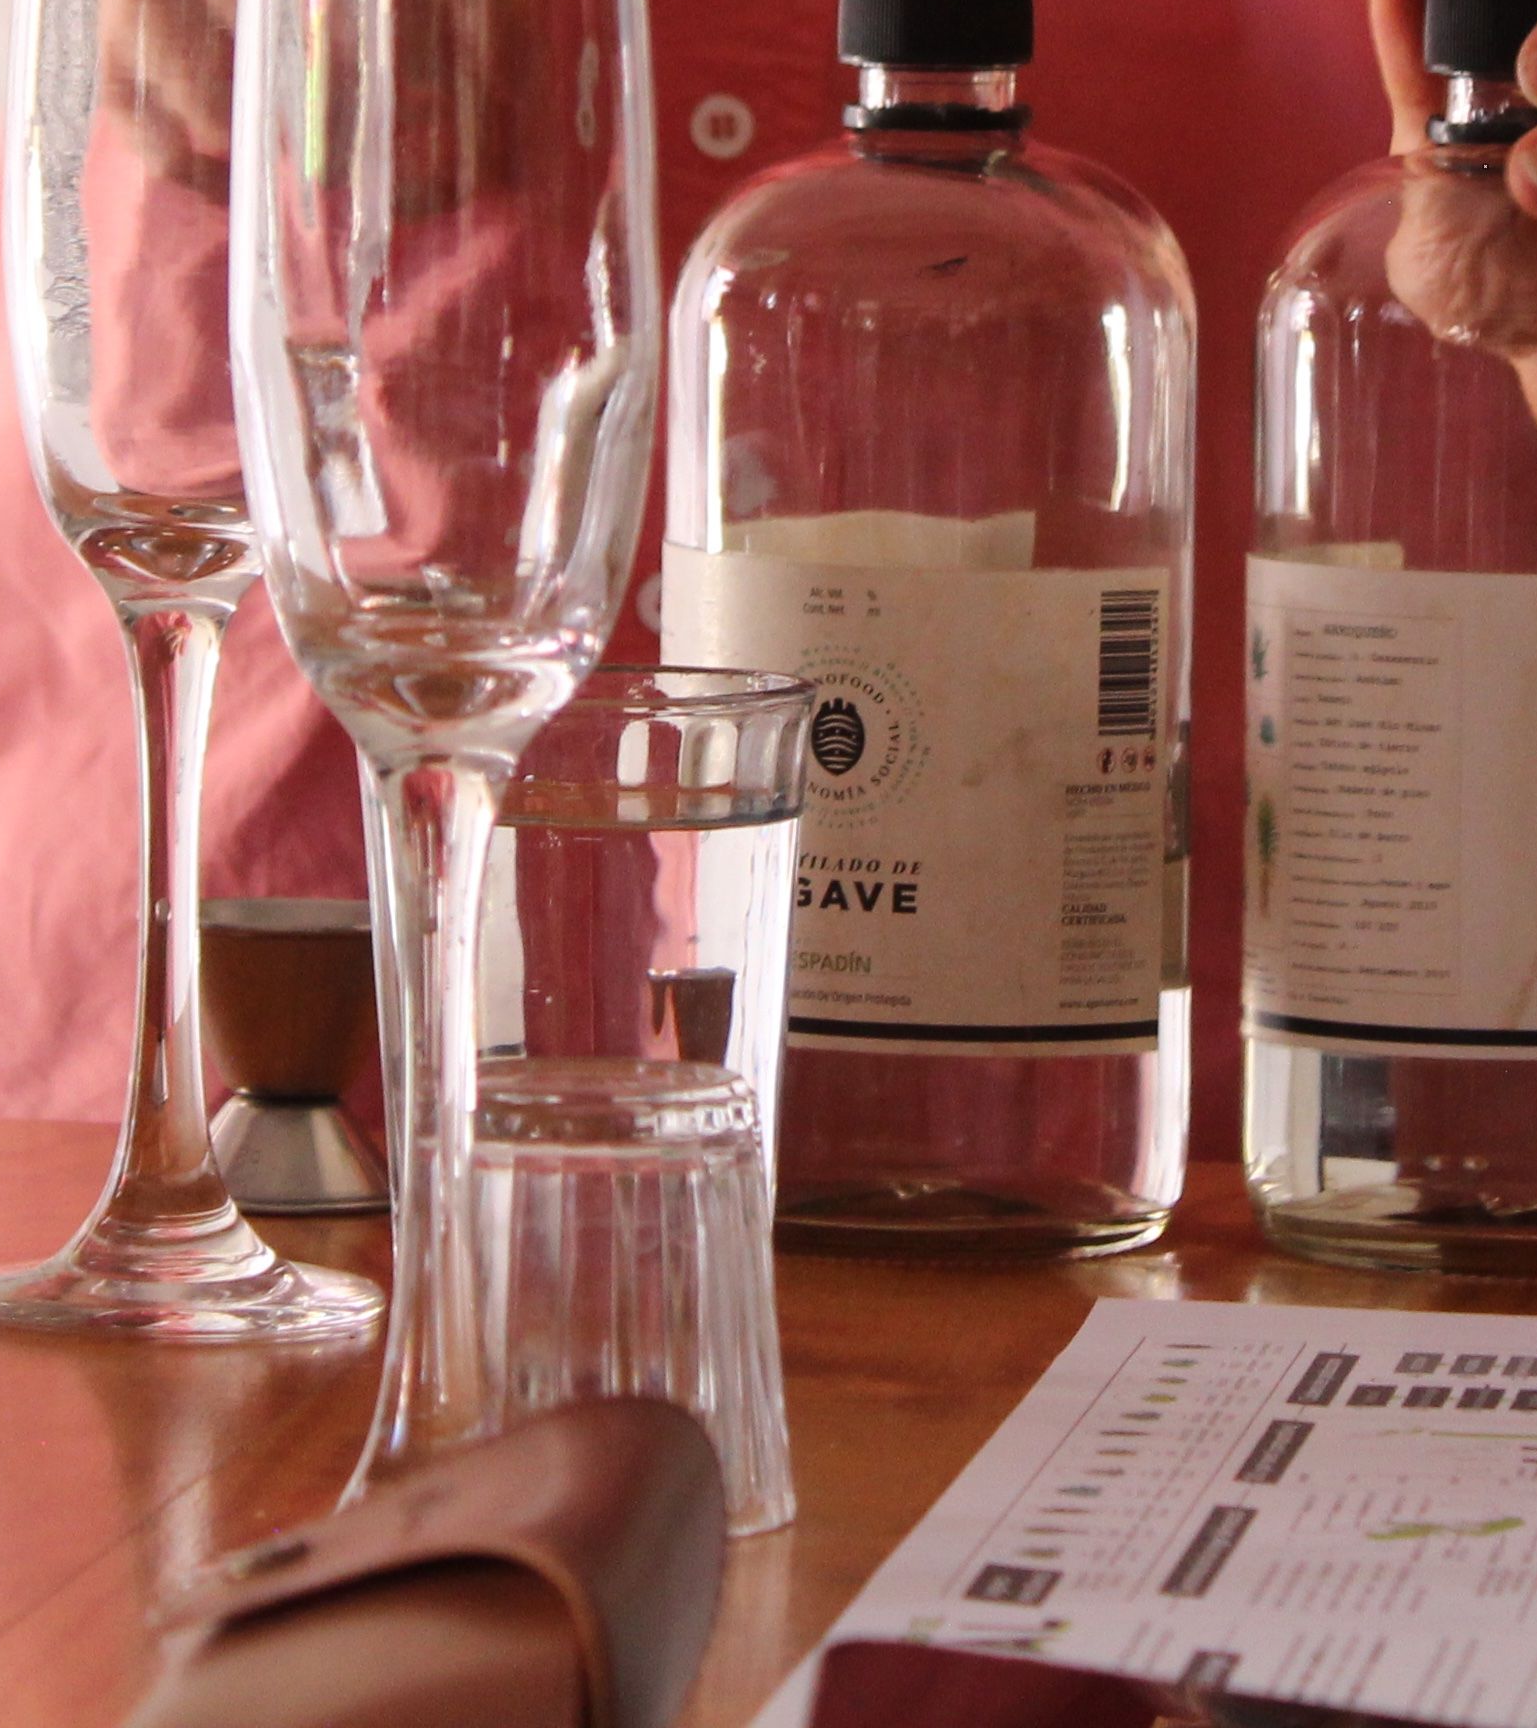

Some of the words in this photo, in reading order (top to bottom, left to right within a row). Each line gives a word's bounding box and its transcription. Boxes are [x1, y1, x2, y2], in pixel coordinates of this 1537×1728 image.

[798, 853, 881, 873] TILADO
[892, 860, 923, 876] DE
[797, 876, 919, 914] GAVE
